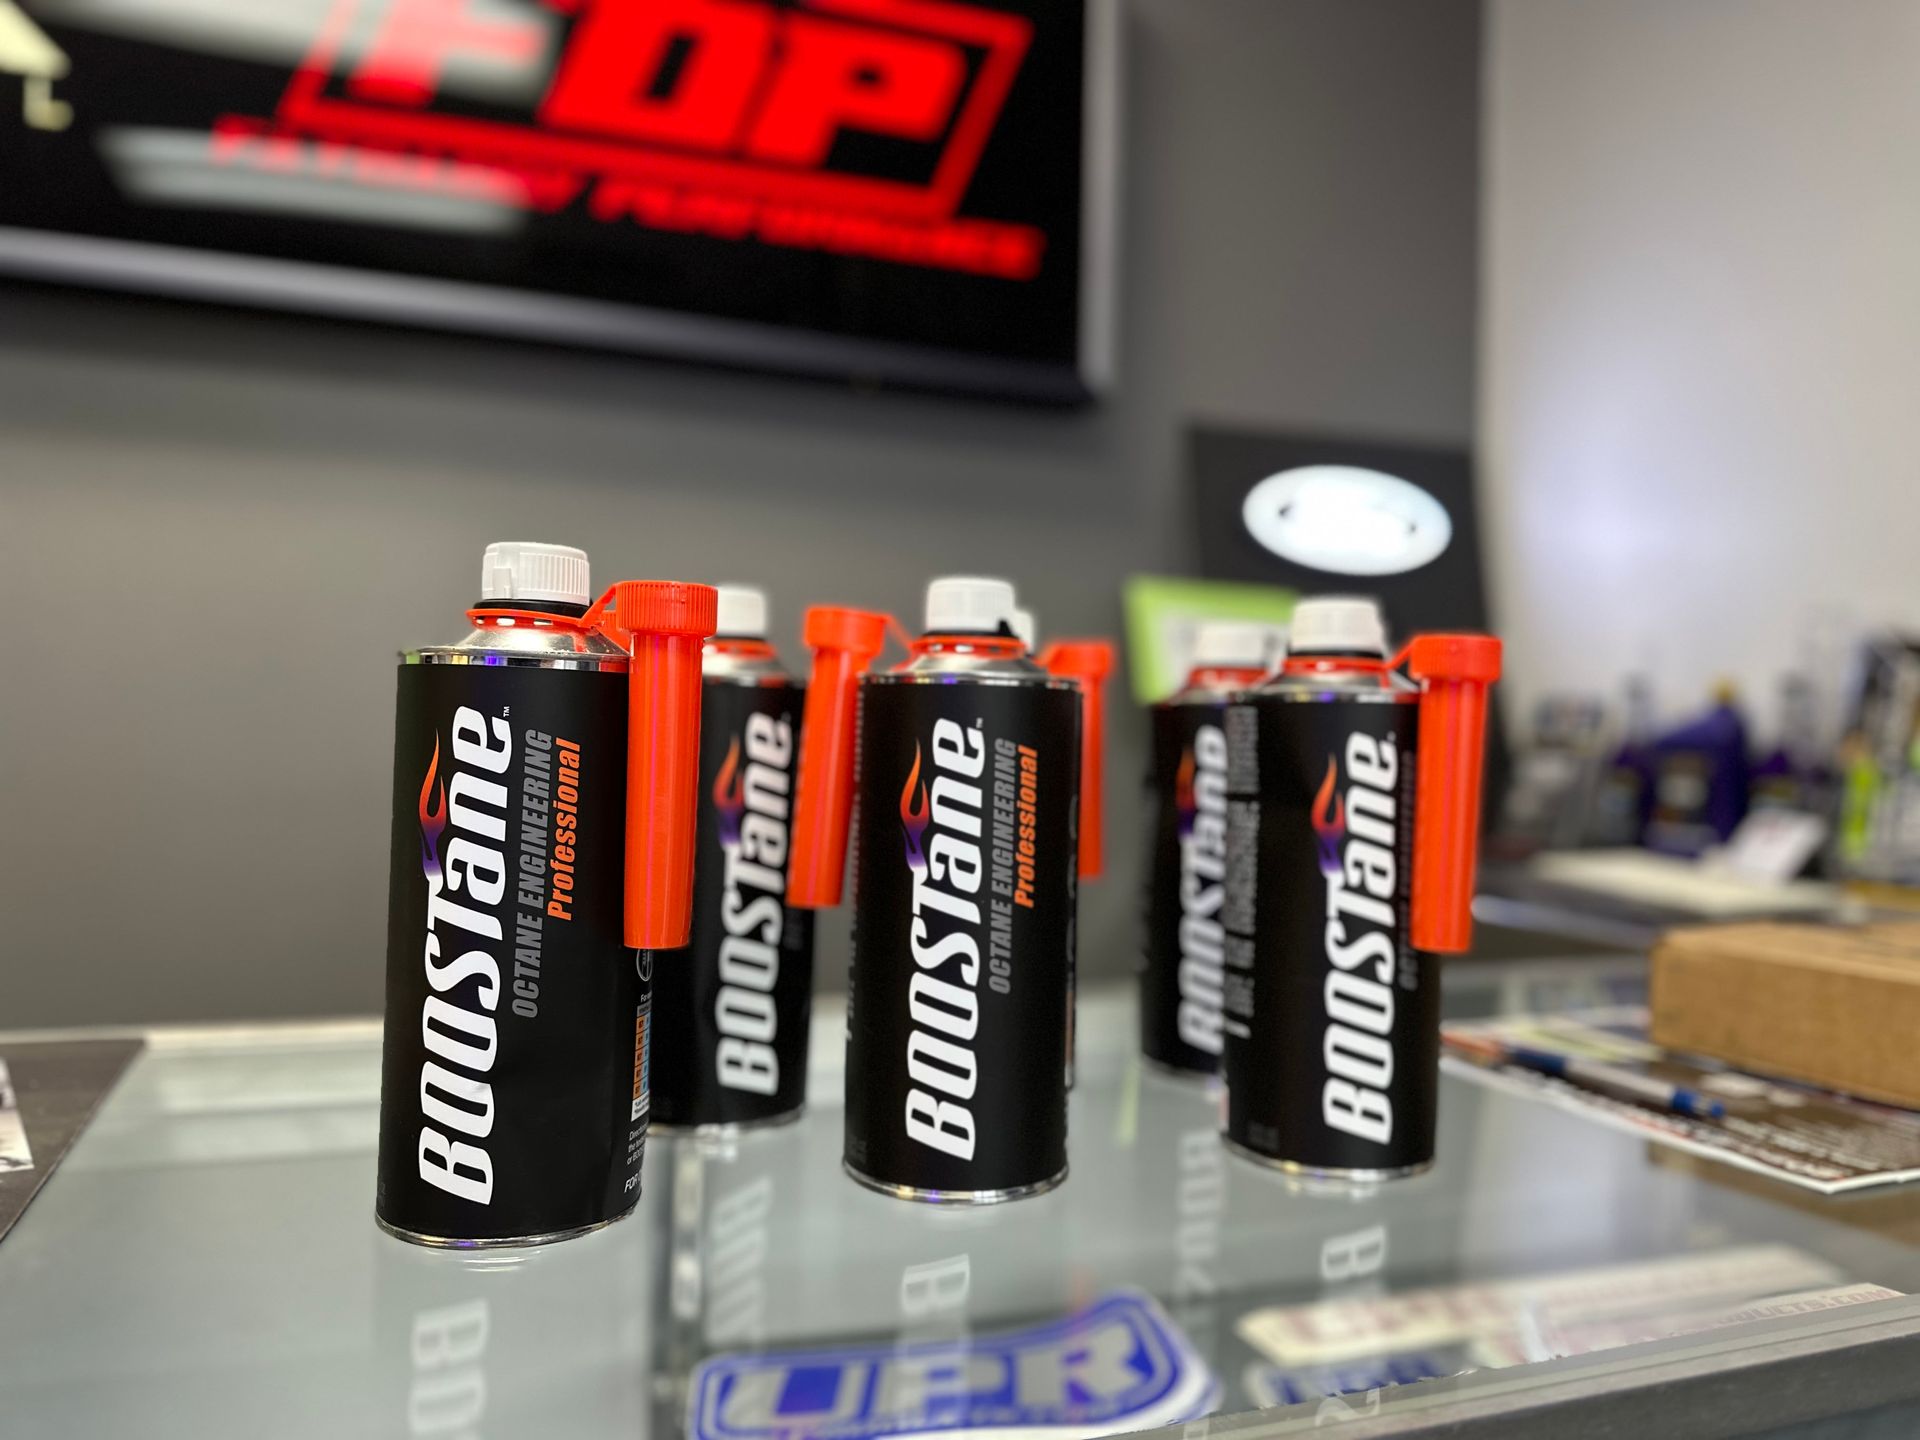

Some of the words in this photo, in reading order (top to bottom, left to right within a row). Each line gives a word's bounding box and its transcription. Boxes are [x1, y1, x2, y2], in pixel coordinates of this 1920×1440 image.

[517, 729, 553, 909] ENGINEERING
[547, 737, 581, 921] Professional
[991, 738, 1017, 897] ENGINEERING
[1014, 745, 1038, 908] Professional
[417, 705, 512, 1205] BOOSTane
[512, 912, 544, 1018] OCTANE
[904, 717, 985, 1161] BOOSTane
[988, 899, 1013, 994] OCTANE
